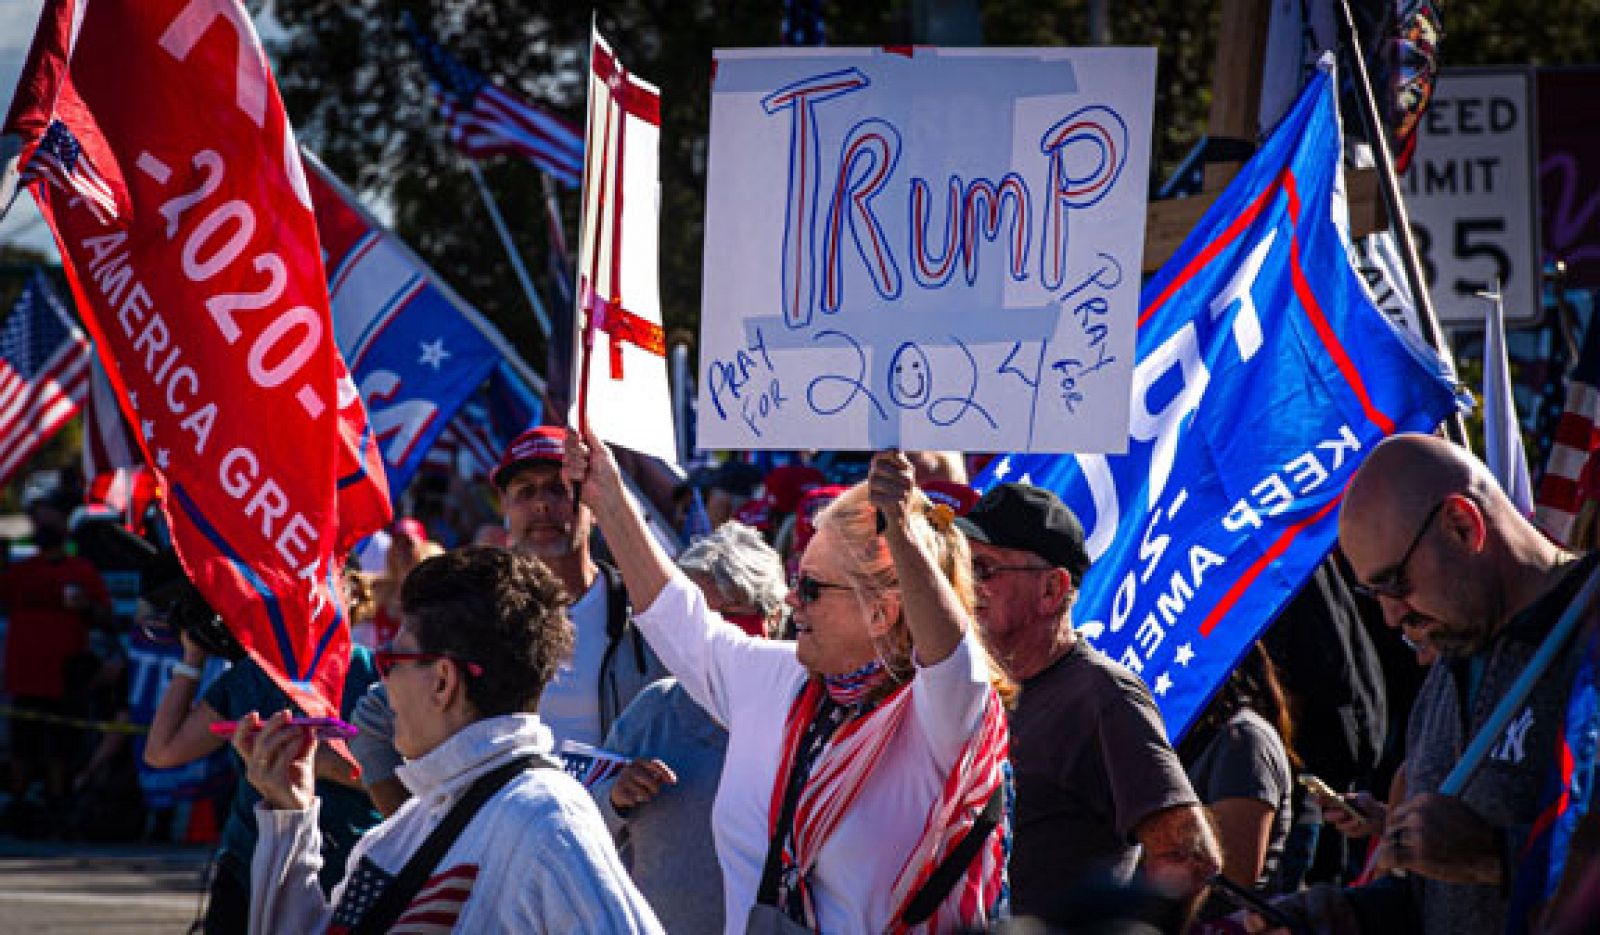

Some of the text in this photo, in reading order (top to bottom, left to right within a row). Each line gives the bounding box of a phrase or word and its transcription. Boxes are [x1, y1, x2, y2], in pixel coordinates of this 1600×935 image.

[1426, 96, 1519, 137] EED
[1408, 154, 1500, 195] IMIT
[82, 231, 218, 455] AMERICA
[1060, 252, 1123, 378] PRAY
[708, 327, 774, 420] PRAY
[741, 378, 789, 437] FOR
[806, 330, 1047, 451] 2024
